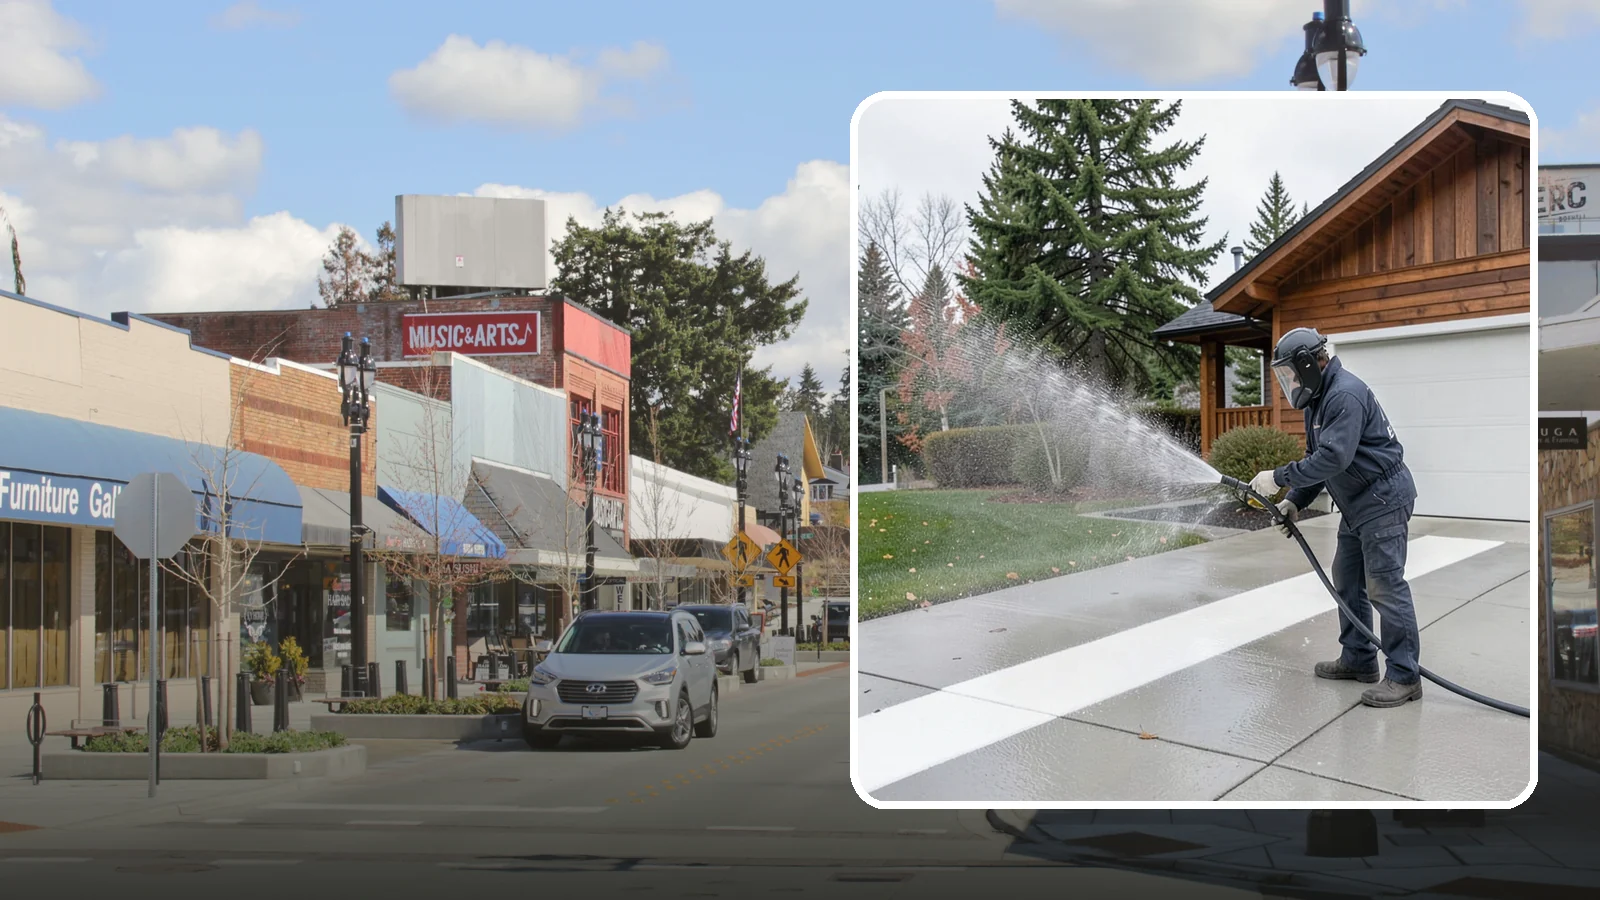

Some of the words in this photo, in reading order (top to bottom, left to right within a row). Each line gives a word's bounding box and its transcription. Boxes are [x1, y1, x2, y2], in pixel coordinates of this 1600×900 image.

[408, 322, 520, 349] MUSIC&ARTS
[0, 471, 79, 516] Furniture
[89, 482, 122, 519] Gal
